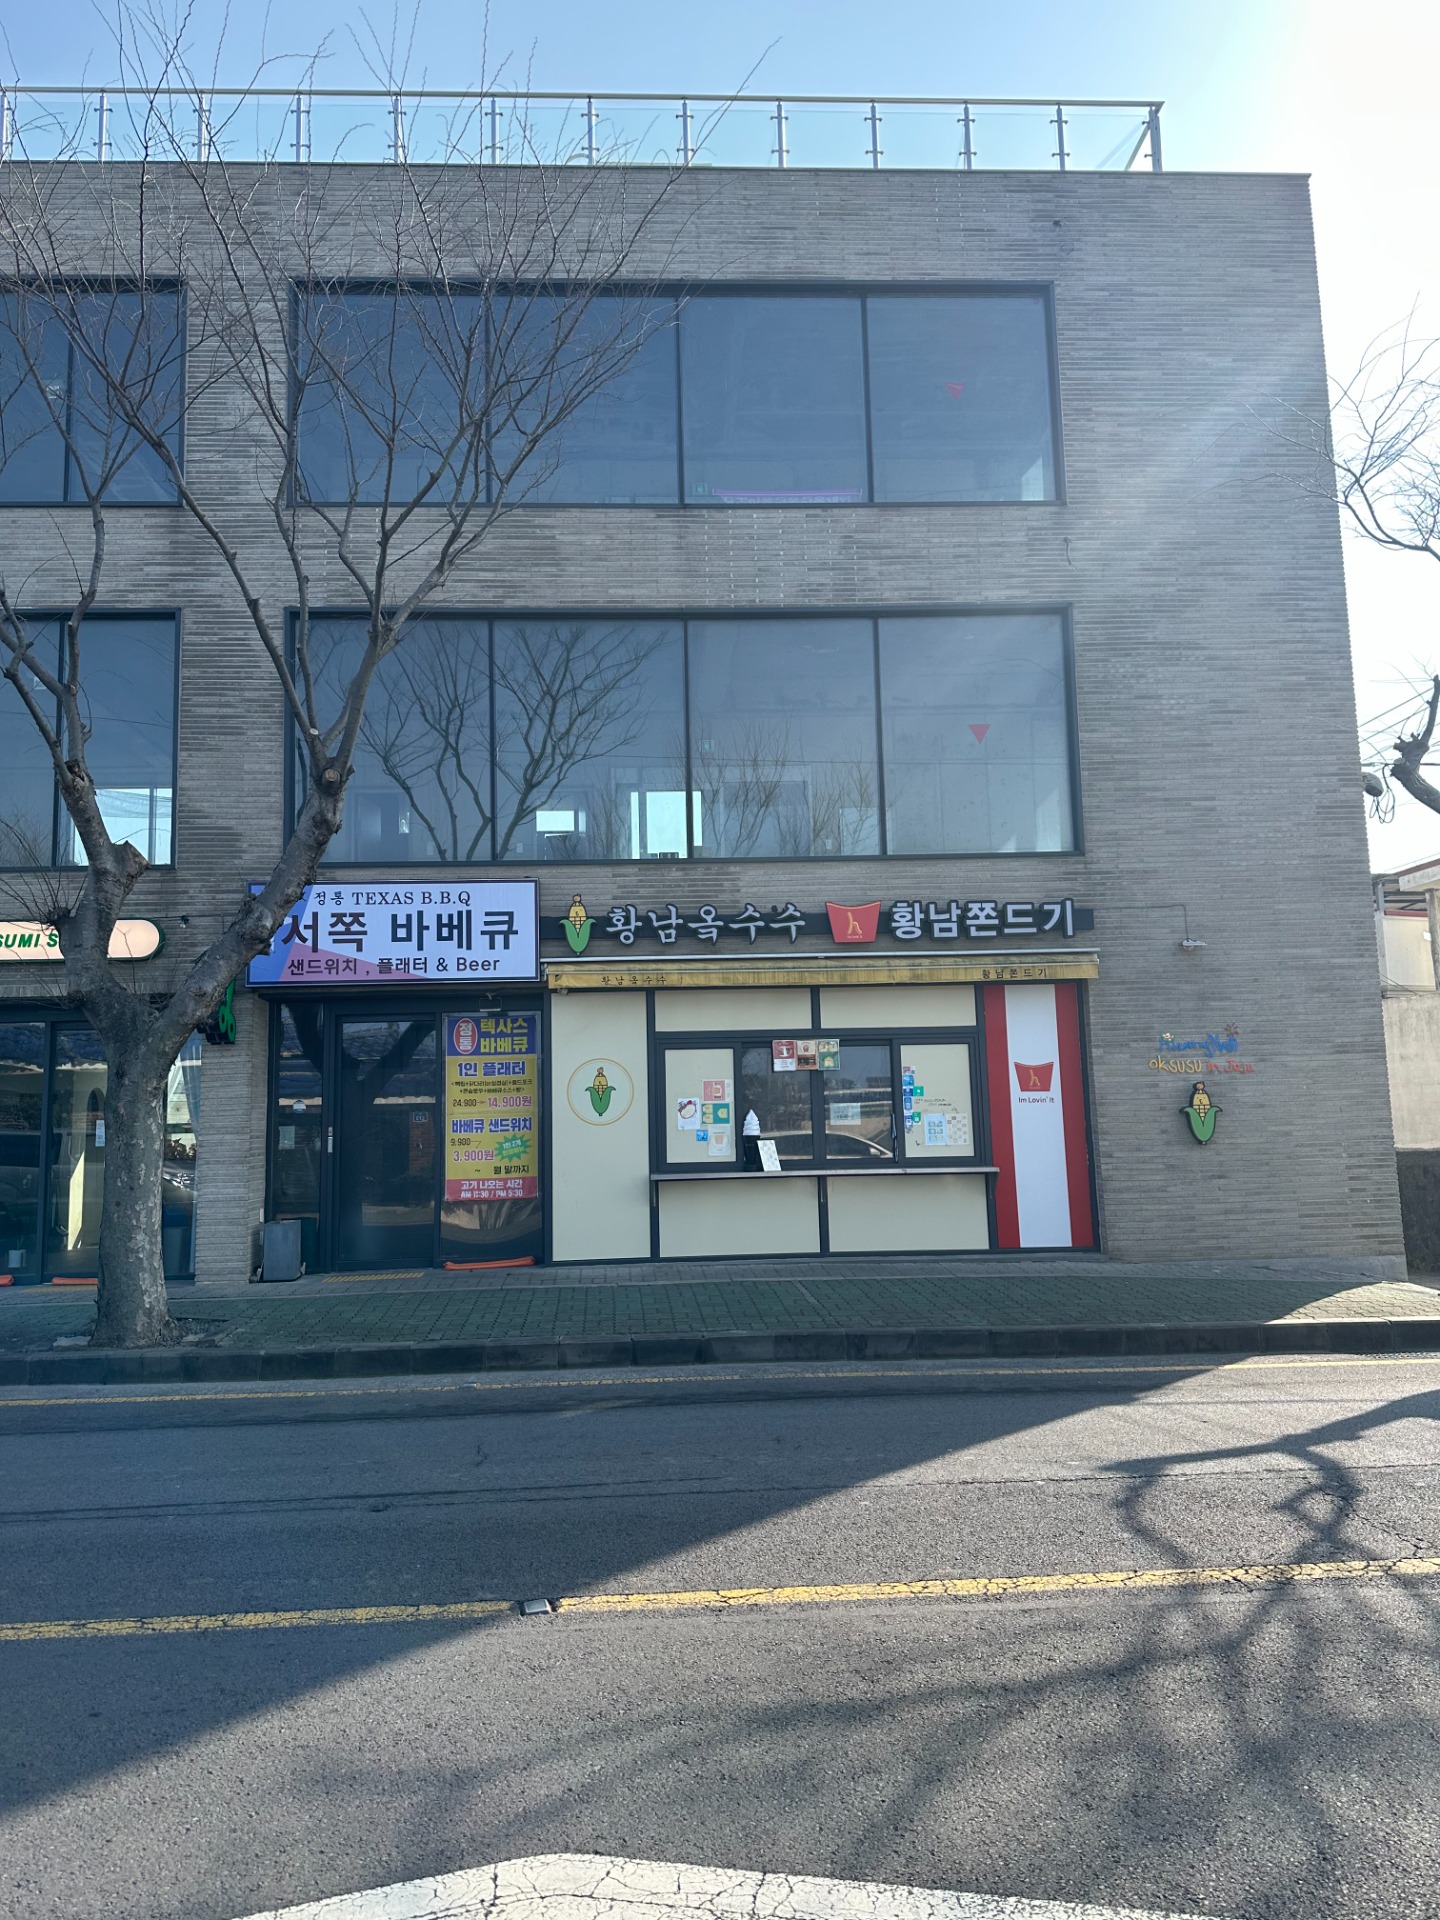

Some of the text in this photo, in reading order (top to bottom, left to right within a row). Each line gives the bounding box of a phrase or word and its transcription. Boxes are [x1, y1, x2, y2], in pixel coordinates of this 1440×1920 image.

[314, 890, 345, 906] 정통
[352, 891, 414, 905] TEXAS
[421, 890, 471, 906] B.B.Q
[606, 904, 806, 944] 황남옥수수
[891, 900, 1074, 940] 황남쫀드기
[281, 909, 519, 953] 서쪽 바베큐
[287, 958, 358, 976] 샌드위치
[376, 957, 428, 974] 플래터
[436, 957, 449, 972] &
[456, 956, 500, 972] Beer
[981, 968, 1048, 979] 황남쫀드기
[601, 975, 667, 985] 황남옥수수
[480, 1018, 528, 1034] 텍사스
[459, 1023, 473, 1051] 정통
[480, 1036, 528, 1053] 바베큐
[457, 1060, 526, 1077] 1인 플래터
[451, 1117, 532, 1133] 바베큐 샌드위치
[461, 1179, 523, 1190] 고기 나오는 시간
[460, 1190, 472, 1199] AM
[495, 1189, 507, 1198] PM
